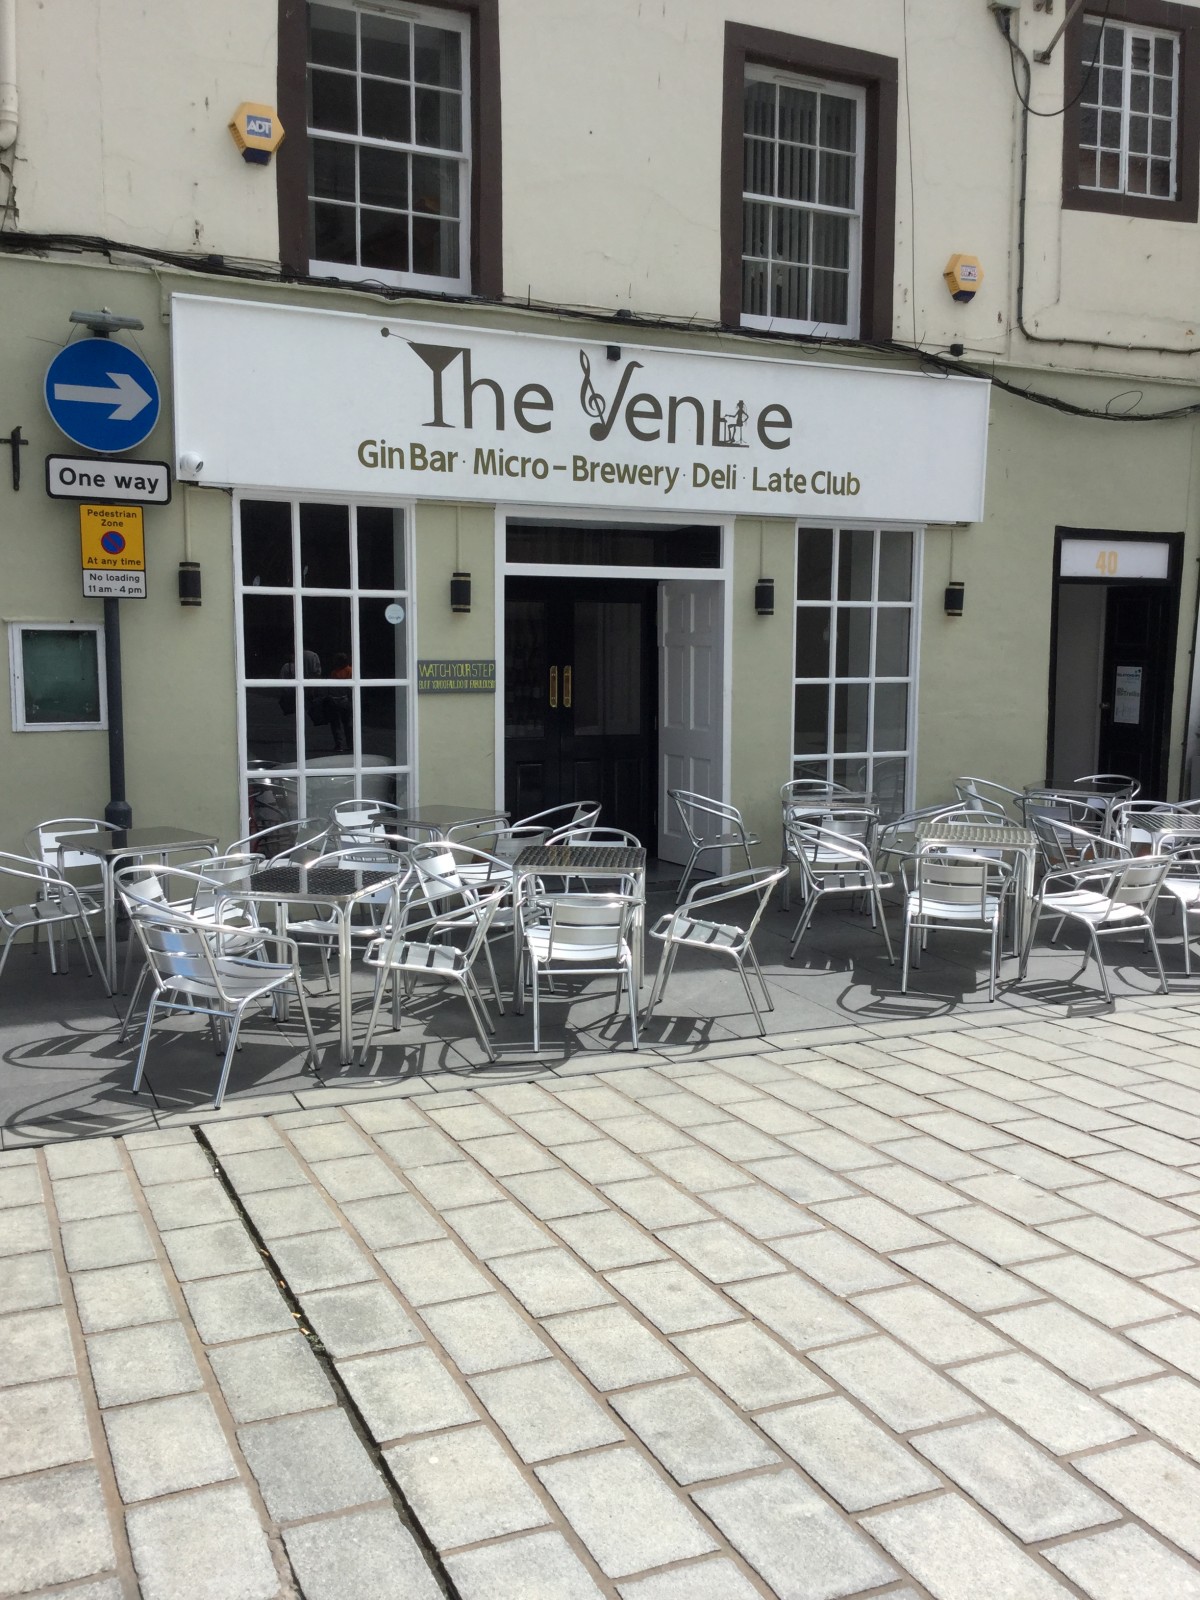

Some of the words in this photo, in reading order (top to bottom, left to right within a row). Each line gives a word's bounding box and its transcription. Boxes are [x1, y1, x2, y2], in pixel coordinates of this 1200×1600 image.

[247, 119, 272, 134] ADT
[407, 342, 554, 434] The
[579, 349, 793, 451] Venue
[357, 439, 405, 470] Gin
[409, 442, 459, 473] Bar
[692, 462, 737, 490] Deli
[752, 467, 807, 494] Late
[811, 470, 861, 496] Club
[59, 467, 106, 488] One
[114, 475, 159, 494] way
[87, 508, 137, 519] Pedestrian
[101, 519, 124, 528] Zone
[87, 556, 98, 565] At
[101, 558, 118, 567] any
[121, 558, 141, 566] time
[1095, 551, 1119, 576] 40
[89, 573, 103, 581] No
[106, 574, 140, 584] loading
[88, 585, 97, 593] 11
[128, 587, 142, 595] pm
[418, 663, 451, 677] WATCH
[451, 663, 472, 677] YOUR
[471, 663, 495, 677] STEP
